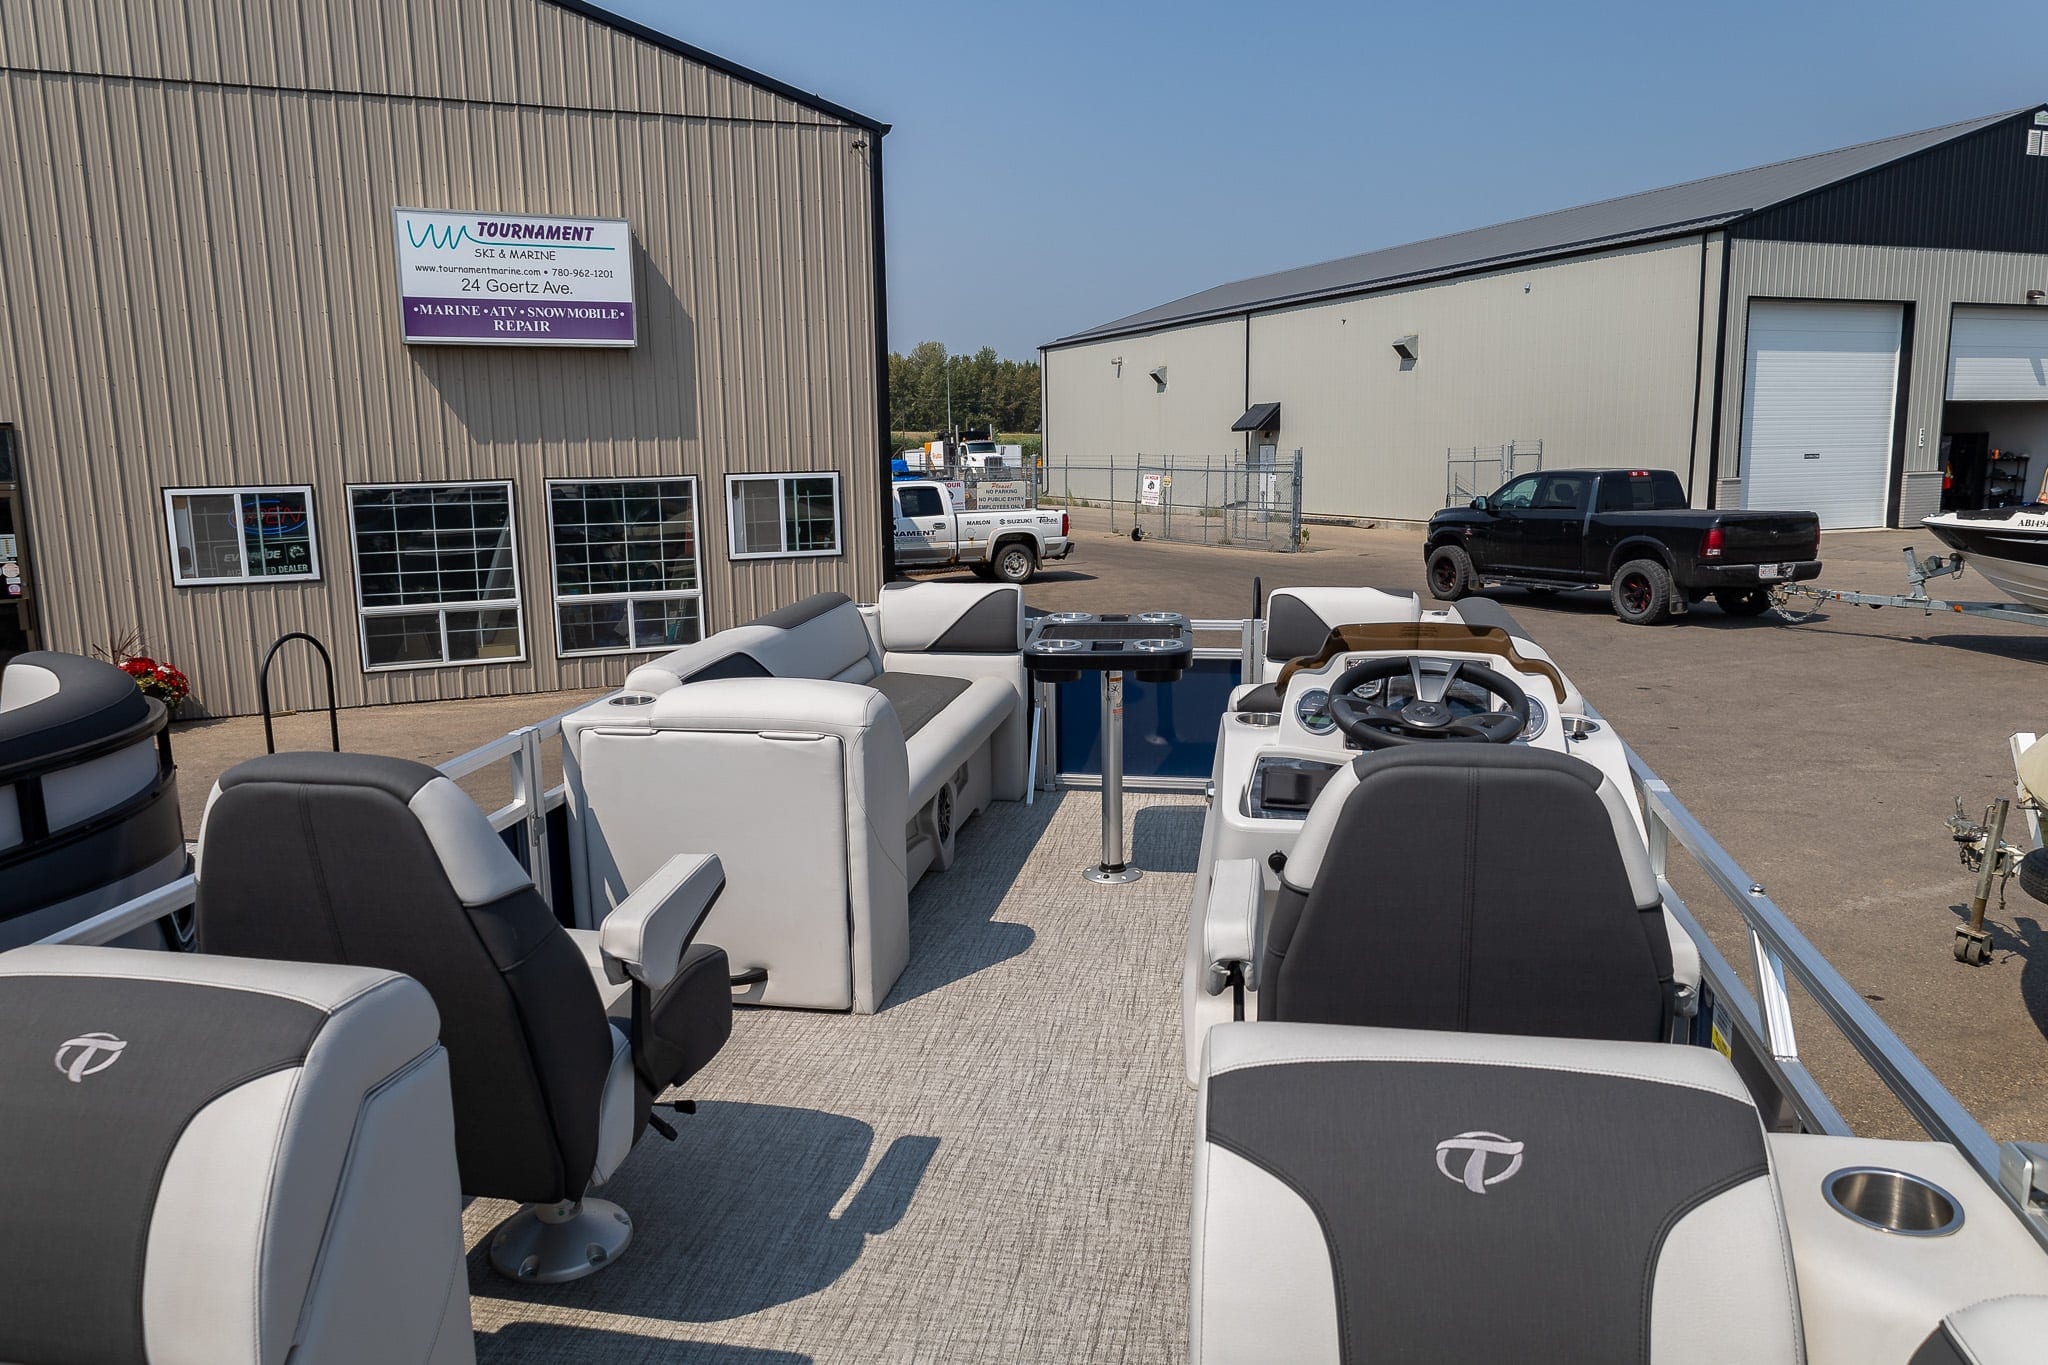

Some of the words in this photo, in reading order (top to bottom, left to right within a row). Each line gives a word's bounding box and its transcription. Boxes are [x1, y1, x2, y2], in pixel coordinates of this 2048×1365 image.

[477, 221, 594, 241] TOURNAMENT
[474, 248, 495, 258] SKI
[498, 248, 506, 259] &
[509, 249, 556, 261] MARINE
[415, 265, 541, 276] www.tournamentmarine.com
[552, 268, 613, 278] 780-962-1201
[461, 278, 480, 292] 24
[486, 278, 539, 294] Goertz
[542, 280, 573, 295] Ave.
[419, 304, 481, 316] MARINE
[489, 306, 518, 317] ATV
[527, 306, 619, 319] SNOWMOBILE
[493, 319, 551, 332] REPAIR
[278, 564, 309, 573] DEALER
